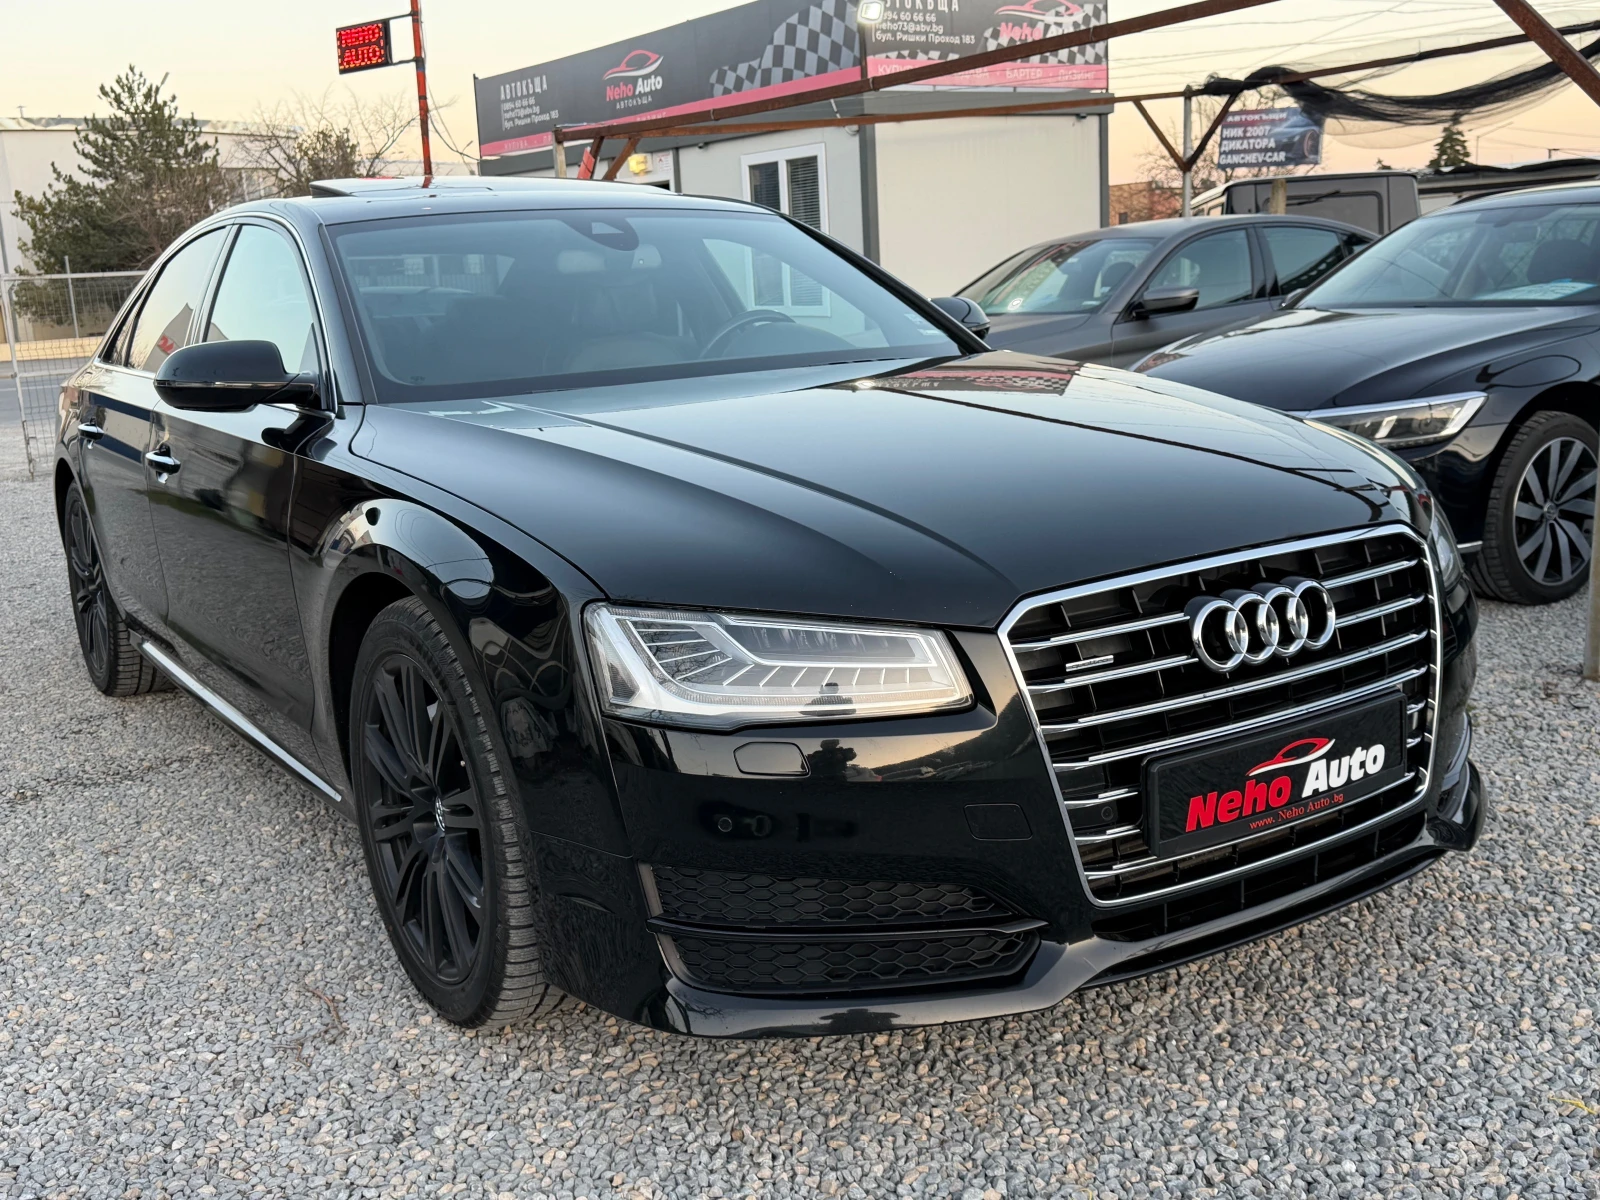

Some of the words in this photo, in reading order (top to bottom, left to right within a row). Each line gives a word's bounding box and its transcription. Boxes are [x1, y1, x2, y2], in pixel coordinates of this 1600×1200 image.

[900, 12, 911, 20] 60
[913, 13, 924, 21] 66
[926, 13, 936, 22] 66
[876, 31, 894, 42] бул.
[896, 32, 926, 42] Ришки
[928, 34, 960, 44] Проход
[961, 34, 975, 44] 183
[1000, 22, 1043, 40] Neho
[343, 45, 381, 66] AUTO
[1006, 68, 1043, 80] БАРТЕР
[1058, 69, 1096, 80] ЛИЗИНГ
[501, 75, 547, 100] АВТОКЪЩА
[606, 81, 634, 102] Neho
[635, 75, 663, 95] Auto
[616, 95, 653, 110] АВТОКЪЩА
[1222, 127, 1245, 139] НИК
[1246, 126, 1271, 138] 2007
[1220, 138, 1276, 153] ДИКАТОРА
[1220, 151, 1286, 165] GANCHEV-CAR
[1185, 775, 1292, 833] Neho
[1301, 743, 1386, 798] Auto
[1250, 815, 1275, 829] www.
[1278, 806, 1304, 822] Neho
[1307, 798, 1330, 813] Auto
[1331, 792, 1344, 804] .bg
